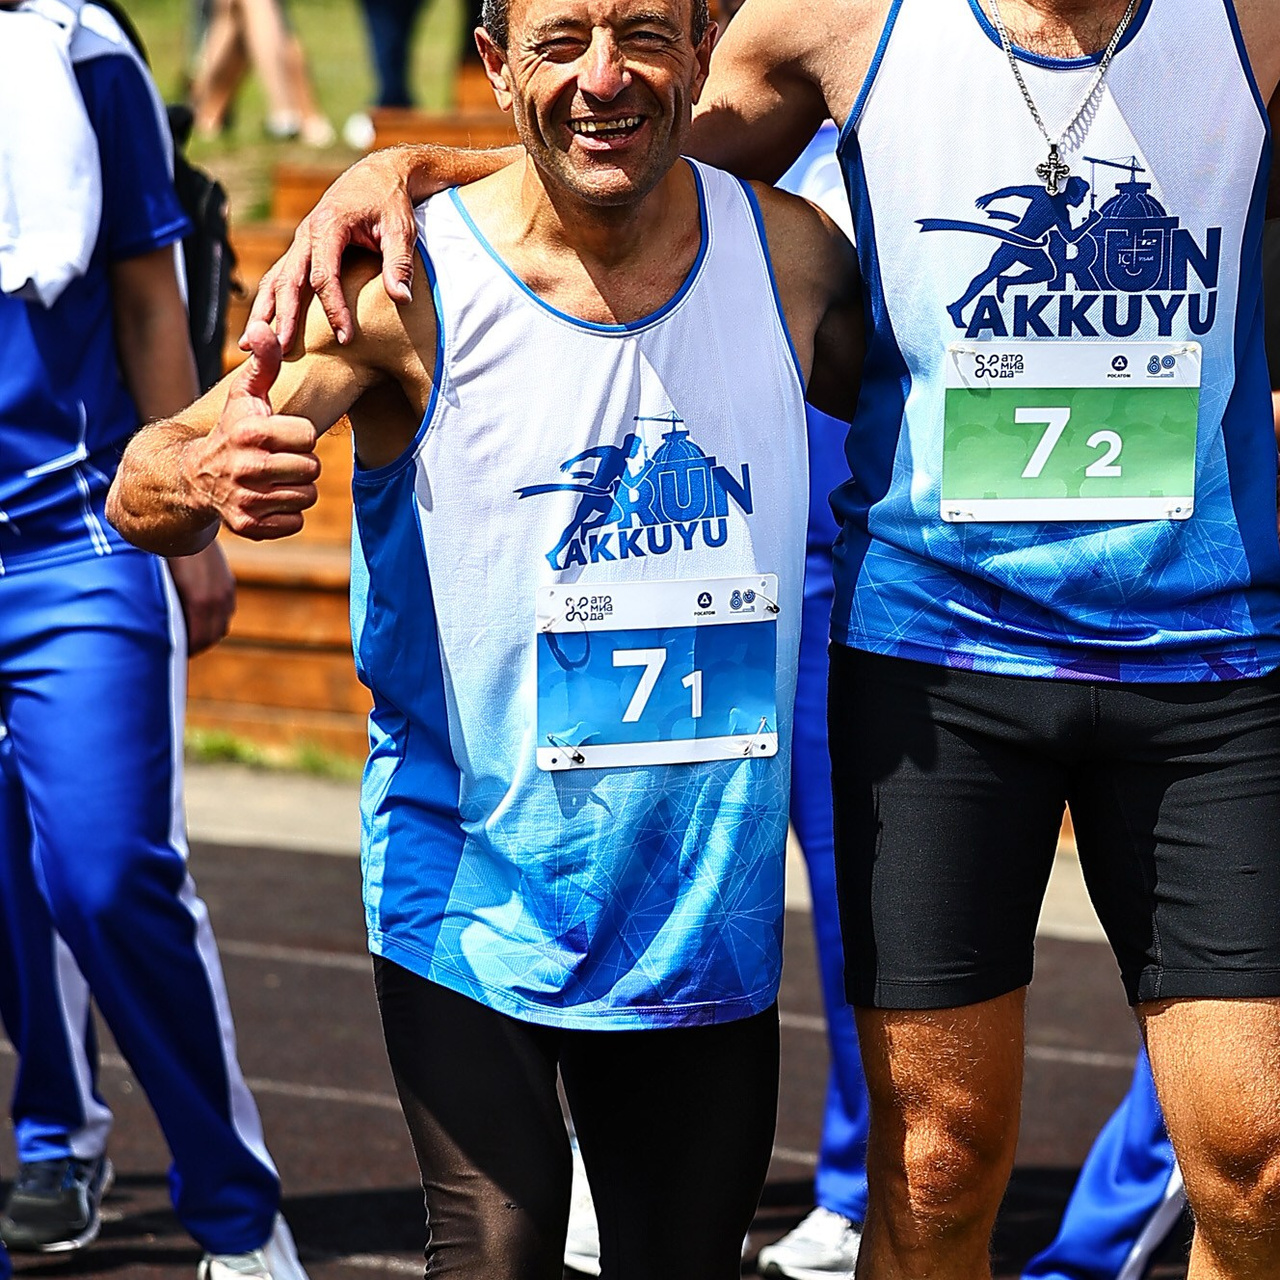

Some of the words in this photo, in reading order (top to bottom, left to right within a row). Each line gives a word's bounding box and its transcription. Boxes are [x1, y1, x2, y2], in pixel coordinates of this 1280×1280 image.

[1047, 227, 1222, 292] RUN
[964, 290, 1219, 338] AKKUYU
[1014, 406, 1071, 479] 7
[1084, 429, 1123, 478] 2
[617, 463, 753, 530] RUN
[563, 518, 727, 571] AKKUYU
[611, 647, 667, 723] 7
[681, 669, 703, 719] 1
